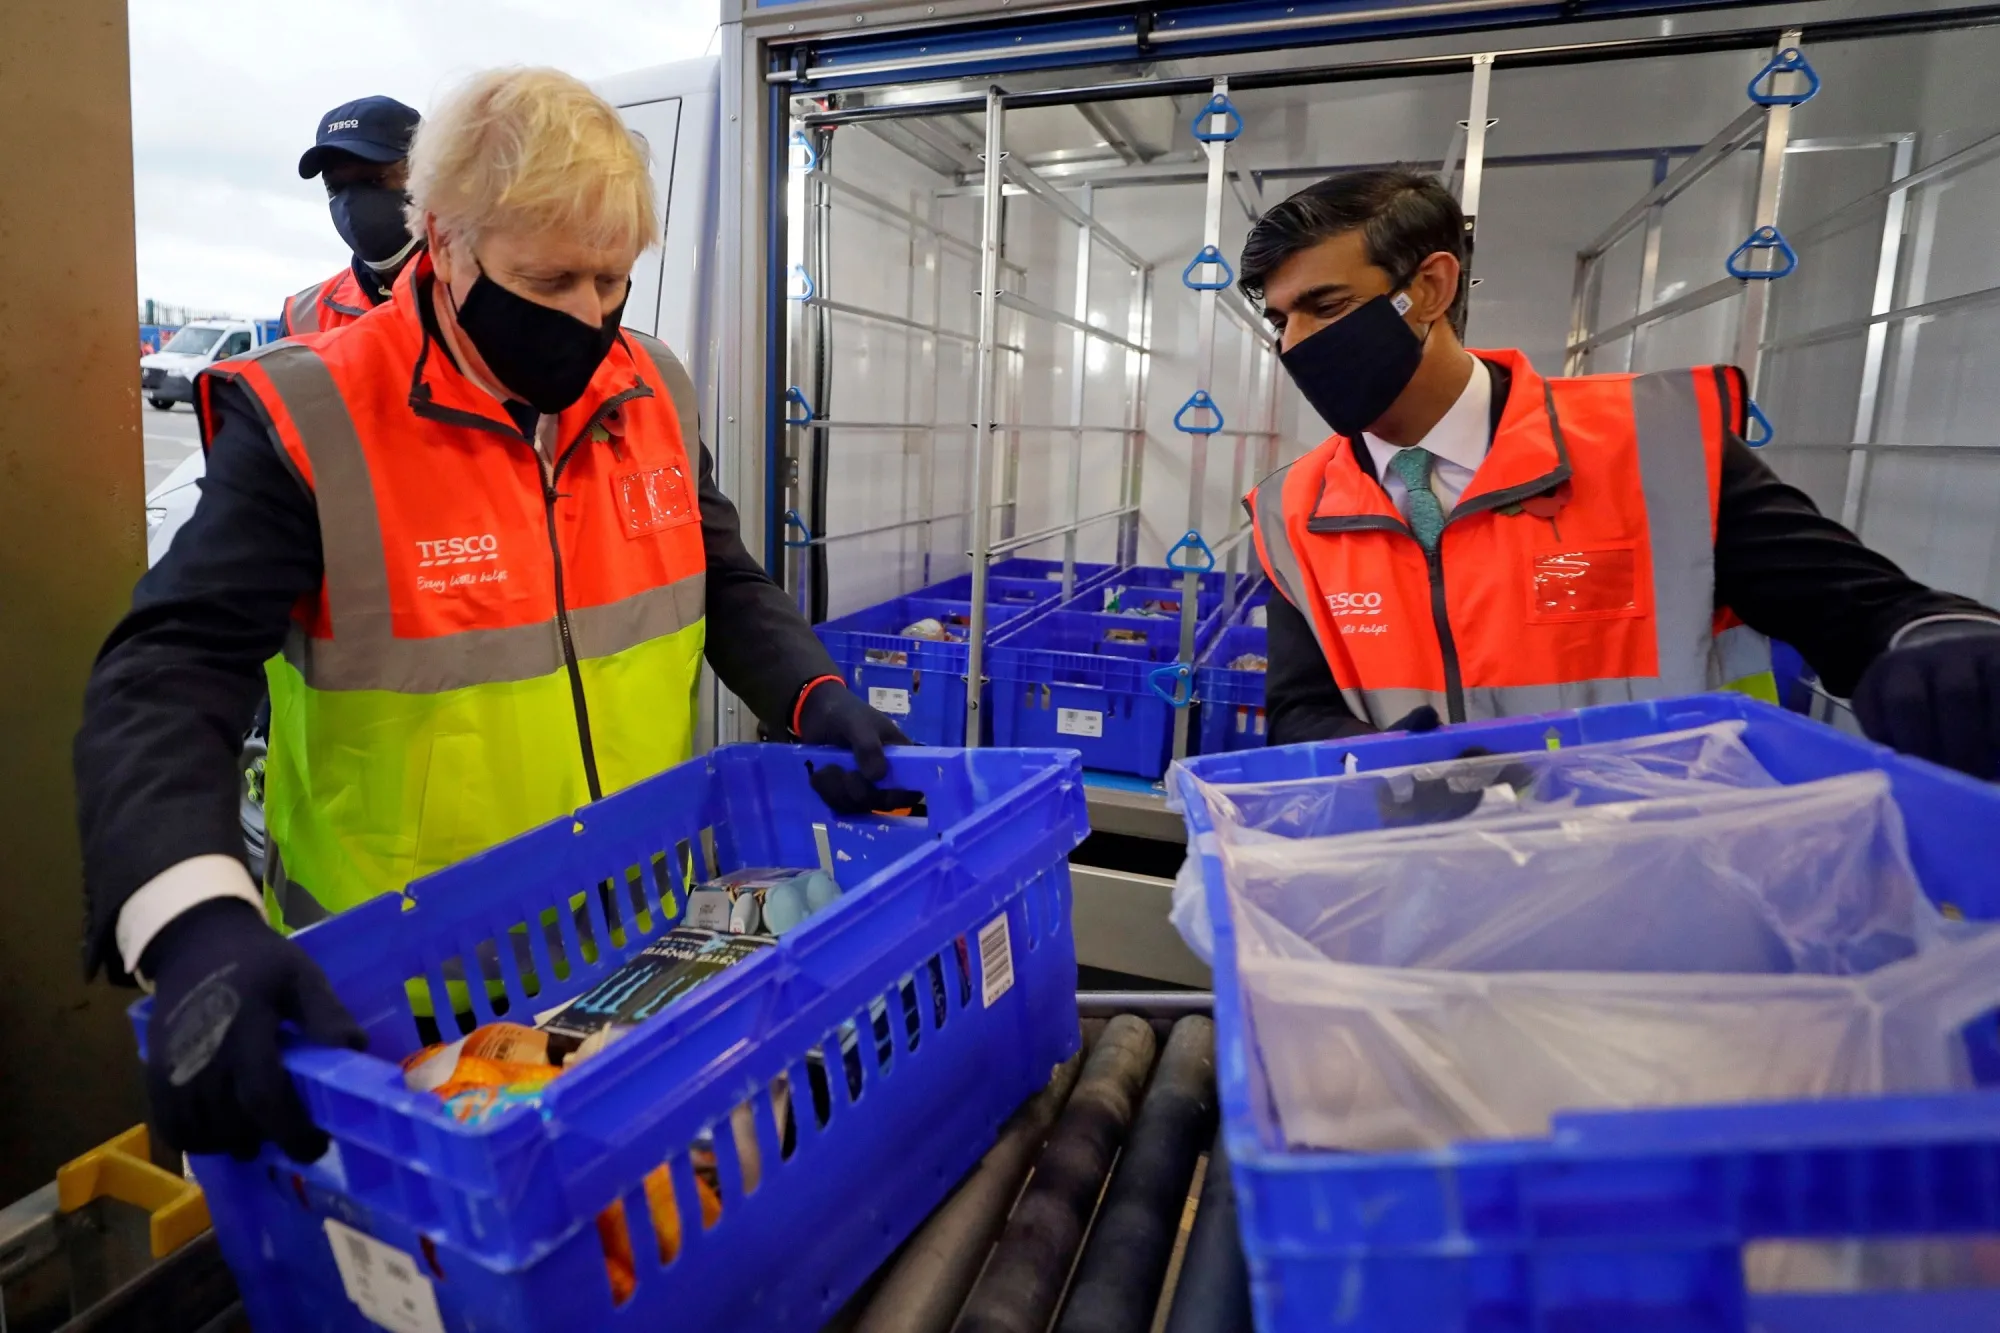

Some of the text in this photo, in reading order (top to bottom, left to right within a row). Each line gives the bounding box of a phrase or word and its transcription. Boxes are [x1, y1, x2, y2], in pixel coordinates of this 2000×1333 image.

[328, 119, 359, 131] TESCO
[415, 534, 497, 558] TESCO
[417, 569, 508, 593] Every little helps
[1325, 592, 1382, 610] ESCO
[1358, 624, 1389, 636] helps
